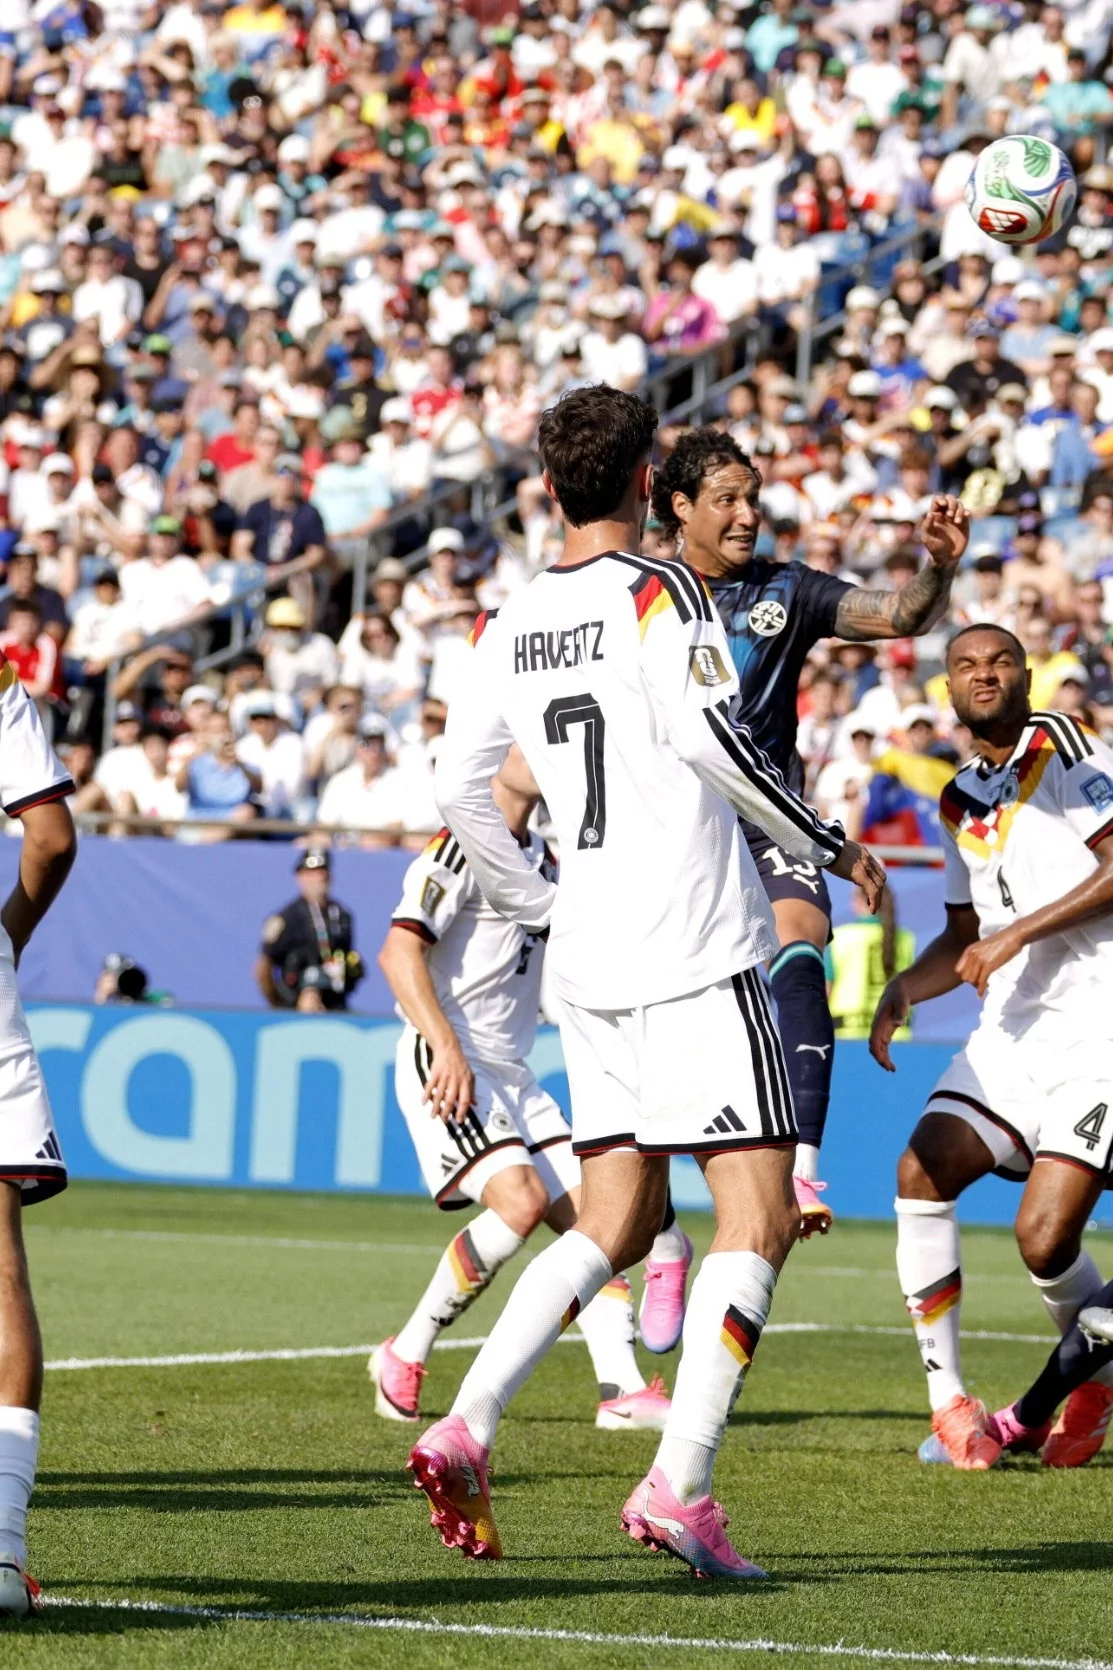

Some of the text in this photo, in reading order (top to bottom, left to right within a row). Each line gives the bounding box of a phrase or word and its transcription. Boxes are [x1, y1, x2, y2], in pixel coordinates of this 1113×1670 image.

[515, 620, 604, 674] HAVERTZ
[543, 693, 605, 850] 7
[997, 865, 1016, 914] 4
[1074, 1102, 1109, 1151] 4
[919, 1338, 935, 1349] FB
